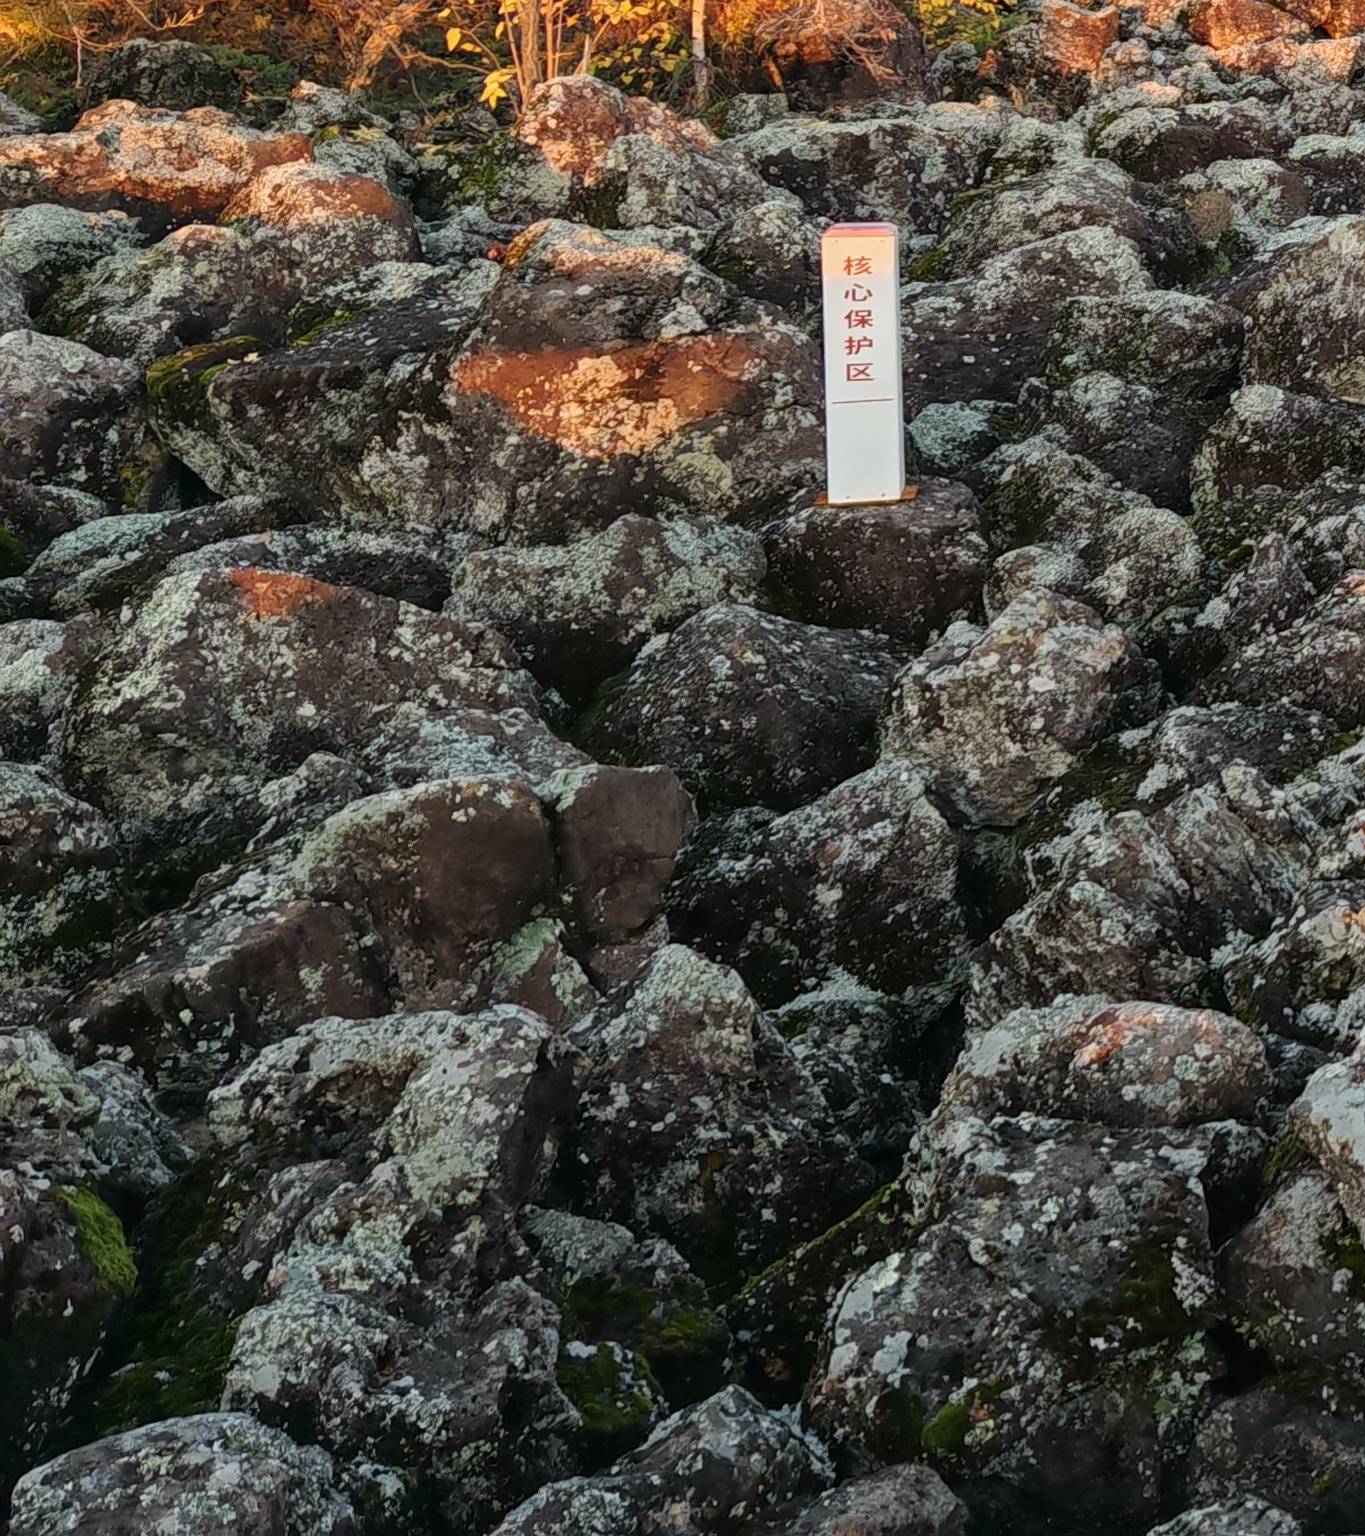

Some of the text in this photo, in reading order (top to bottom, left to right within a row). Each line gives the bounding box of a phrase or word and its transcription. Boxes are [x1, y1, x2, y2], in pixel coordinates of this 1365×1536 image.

[843, 255, 874, 382] 核心保护区
